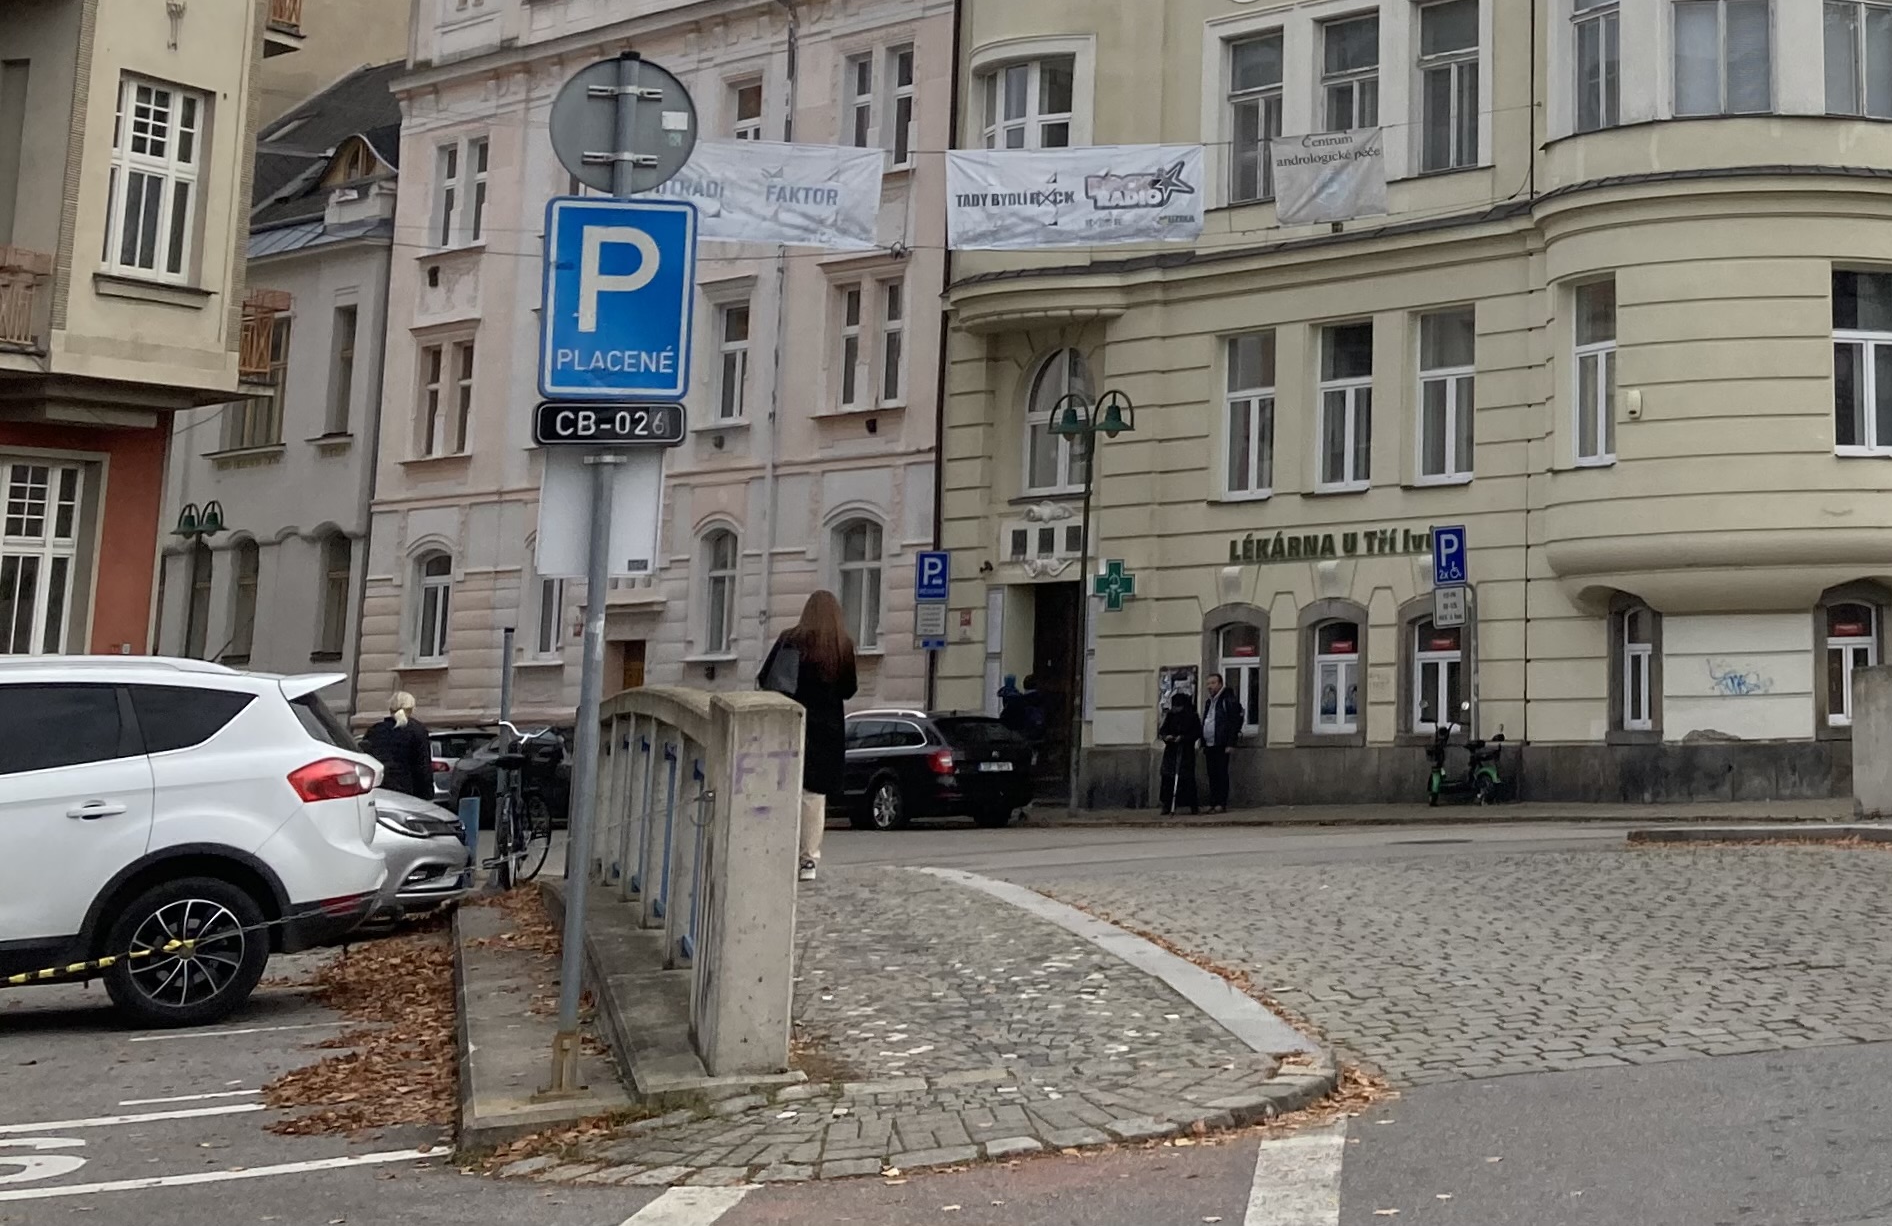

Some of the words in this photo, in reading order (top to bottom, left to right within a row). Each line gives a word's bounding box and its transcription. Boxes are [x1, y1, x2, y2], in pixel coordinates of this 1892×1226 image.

[1302, 135, 1353, 148] Centrum
[765, 183, 839, 207] FAKTOR
[956, 192, 988, 208] TADY
[991, 190, 1027, 208] BYDLÍ
[578, 225, 660, 333] P
[556, 345, 674, 374] PLACENÉ
[556, 410, 666, 437] CB-026
[1228, 530, 1338, 562] LÉKÁRNA
[1342, 532, 1358, 556] U
[1440, 534, 1459, 567] P
[923, 557, 942, 585] P
